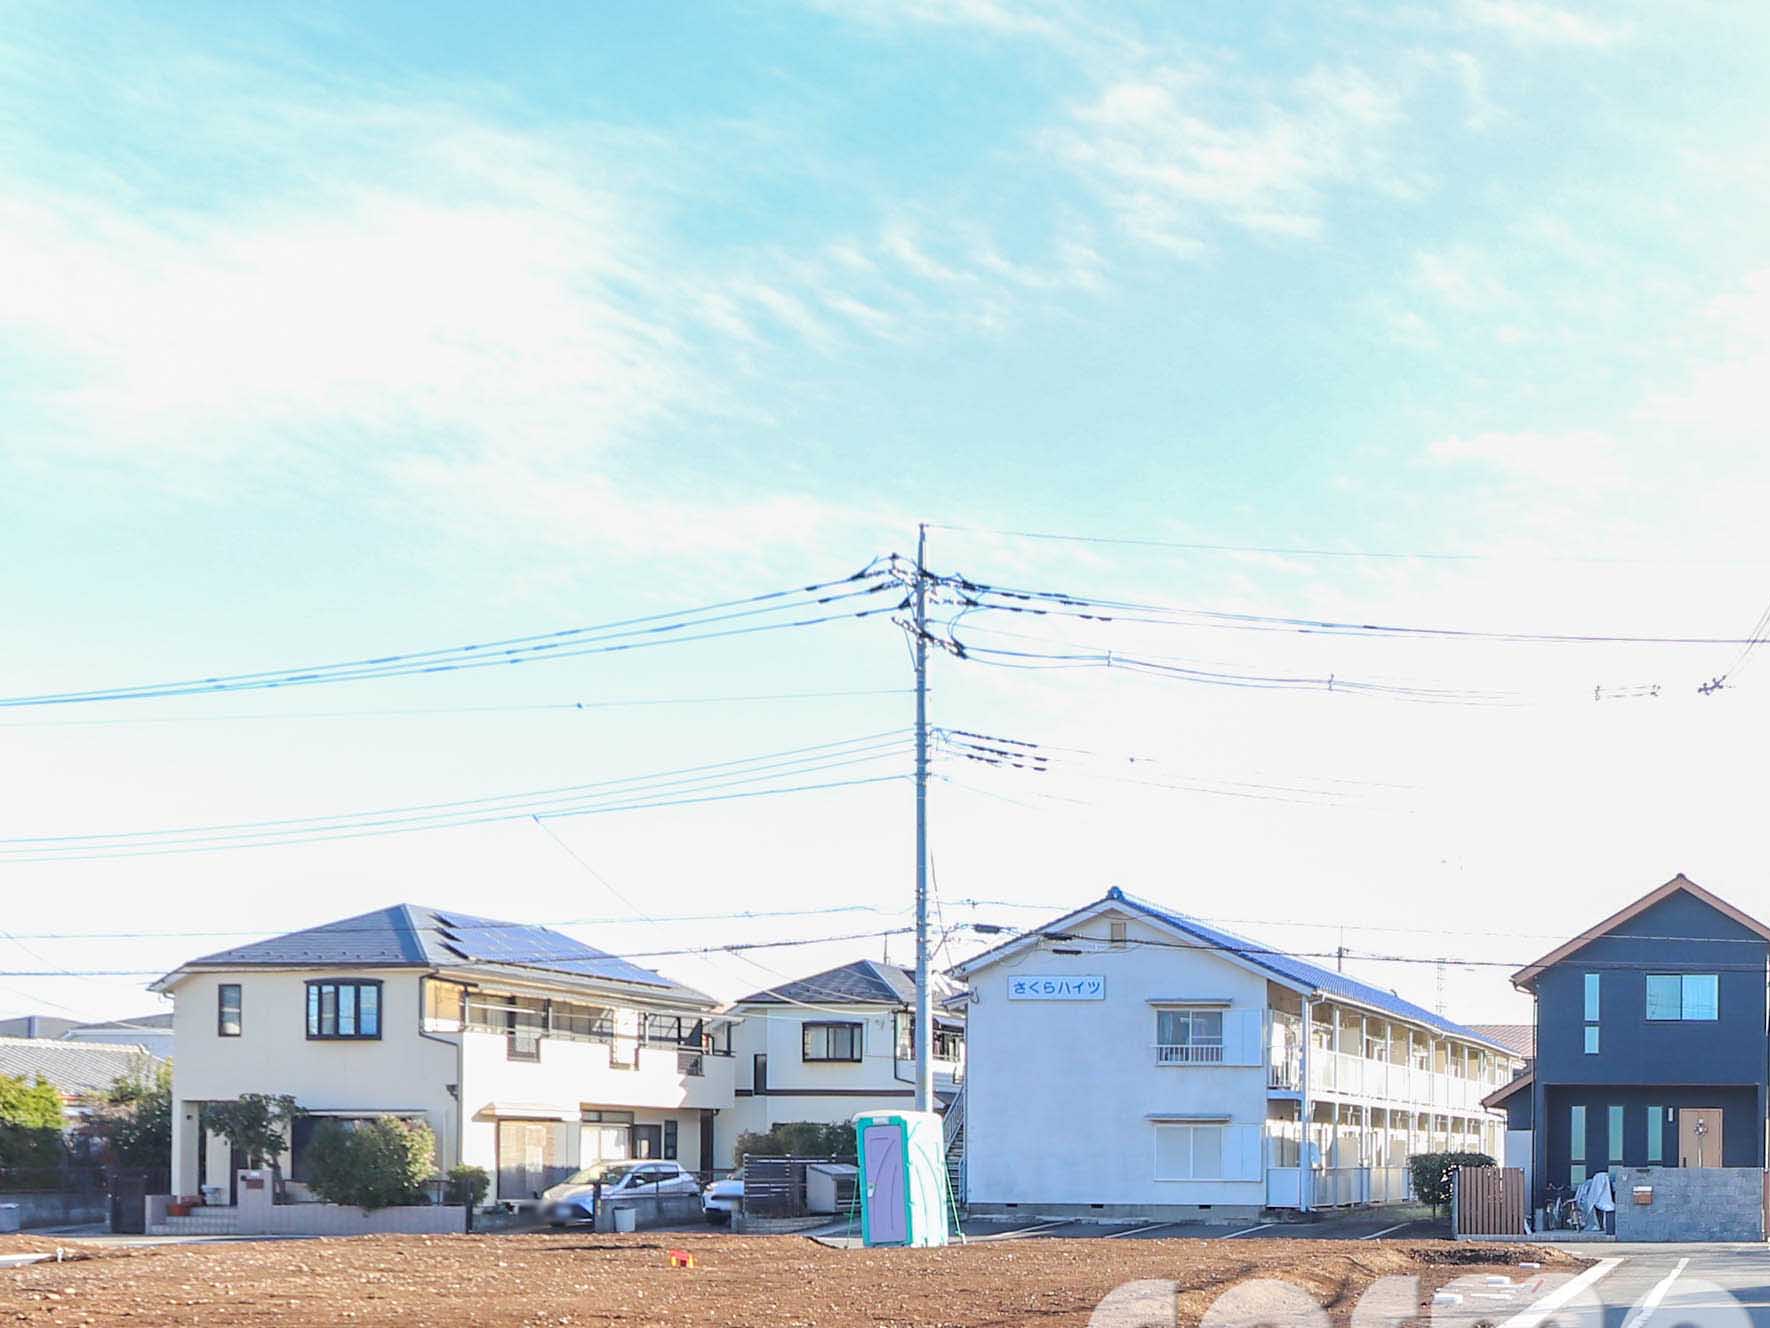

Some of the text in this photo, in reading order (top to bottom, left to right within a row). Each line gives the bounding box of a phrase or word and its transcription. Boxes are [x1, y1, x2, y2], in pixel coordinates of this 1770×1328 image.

[1014, 980, 1101, 995] さくらハイツ
